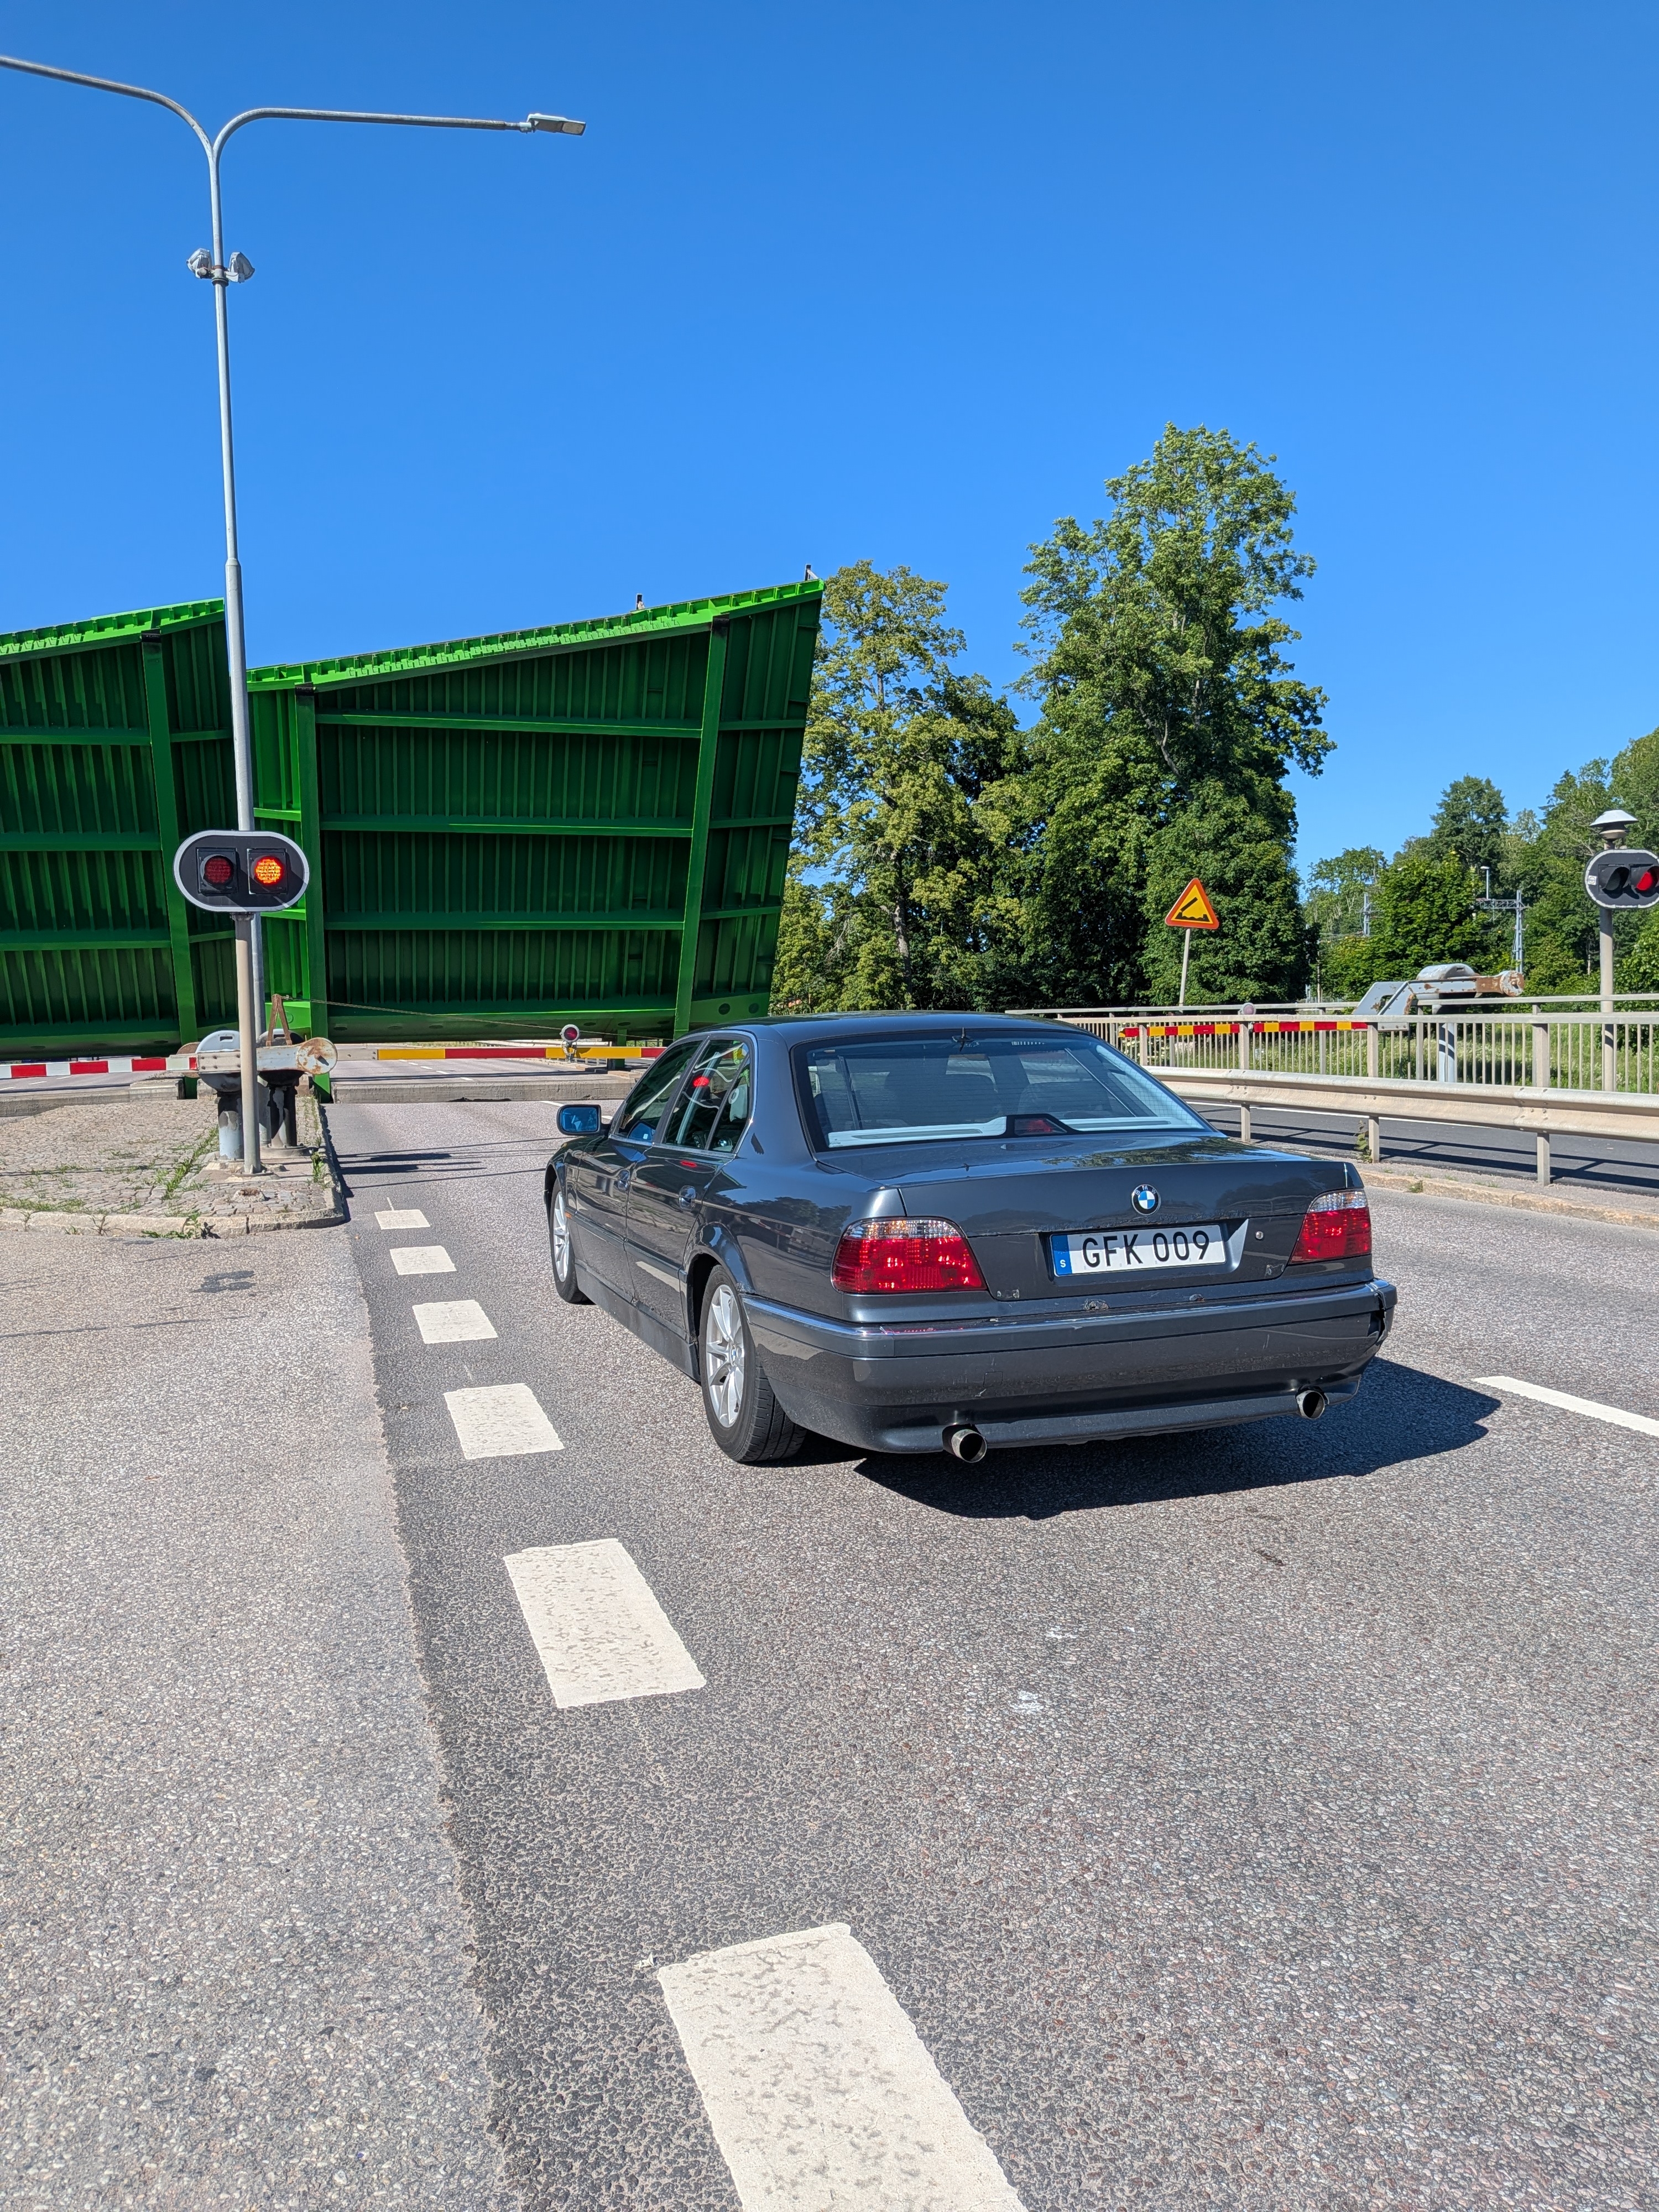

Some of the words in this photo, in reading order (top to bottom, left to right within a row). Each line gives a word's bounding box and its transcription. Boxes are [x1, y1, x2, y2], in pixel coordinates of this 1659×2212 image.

[1135, 1185, 1156, 1196] BMW
[1082, 1234, 1143, 1267] GFK
[1152, 1230, 1209, 1262] 009
[1060, 1259, 1066, 1267] S
